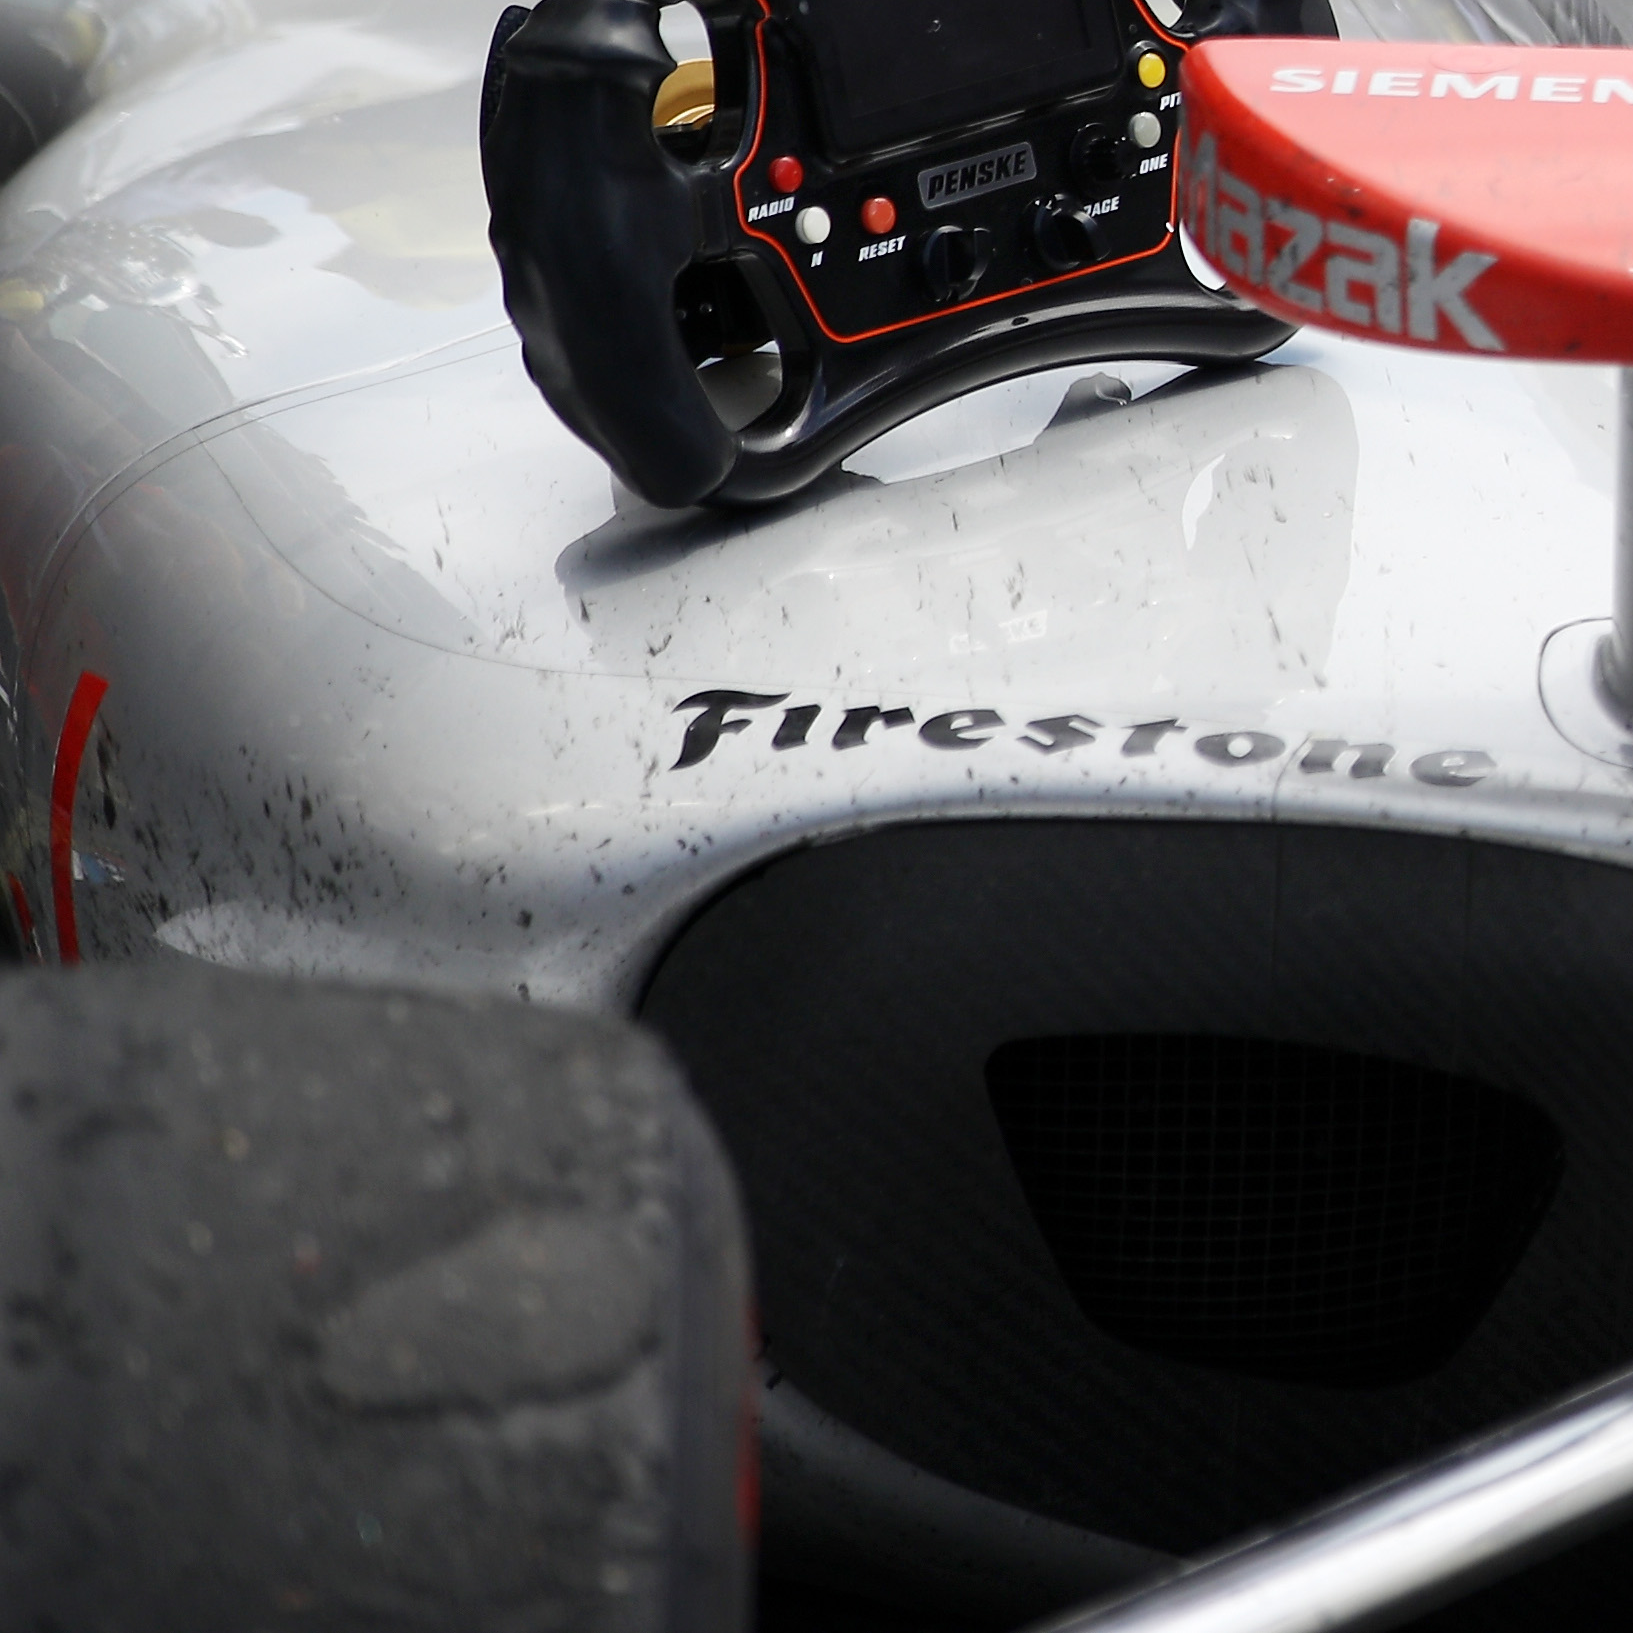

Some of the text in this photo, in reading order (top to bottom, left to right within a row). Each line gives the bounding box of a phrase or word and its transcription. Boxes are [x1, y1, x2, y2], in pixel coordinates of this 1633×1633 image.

[927, 150, 1027, 201] PENSKE
[1139, 153, 1169, 175] ONE
[748, 197, 795, 222] RADIO
[811, 251, 823, 267] N
[858, 235, 906, 262] RESET
[668, 688, 1498, 787] Firestone
